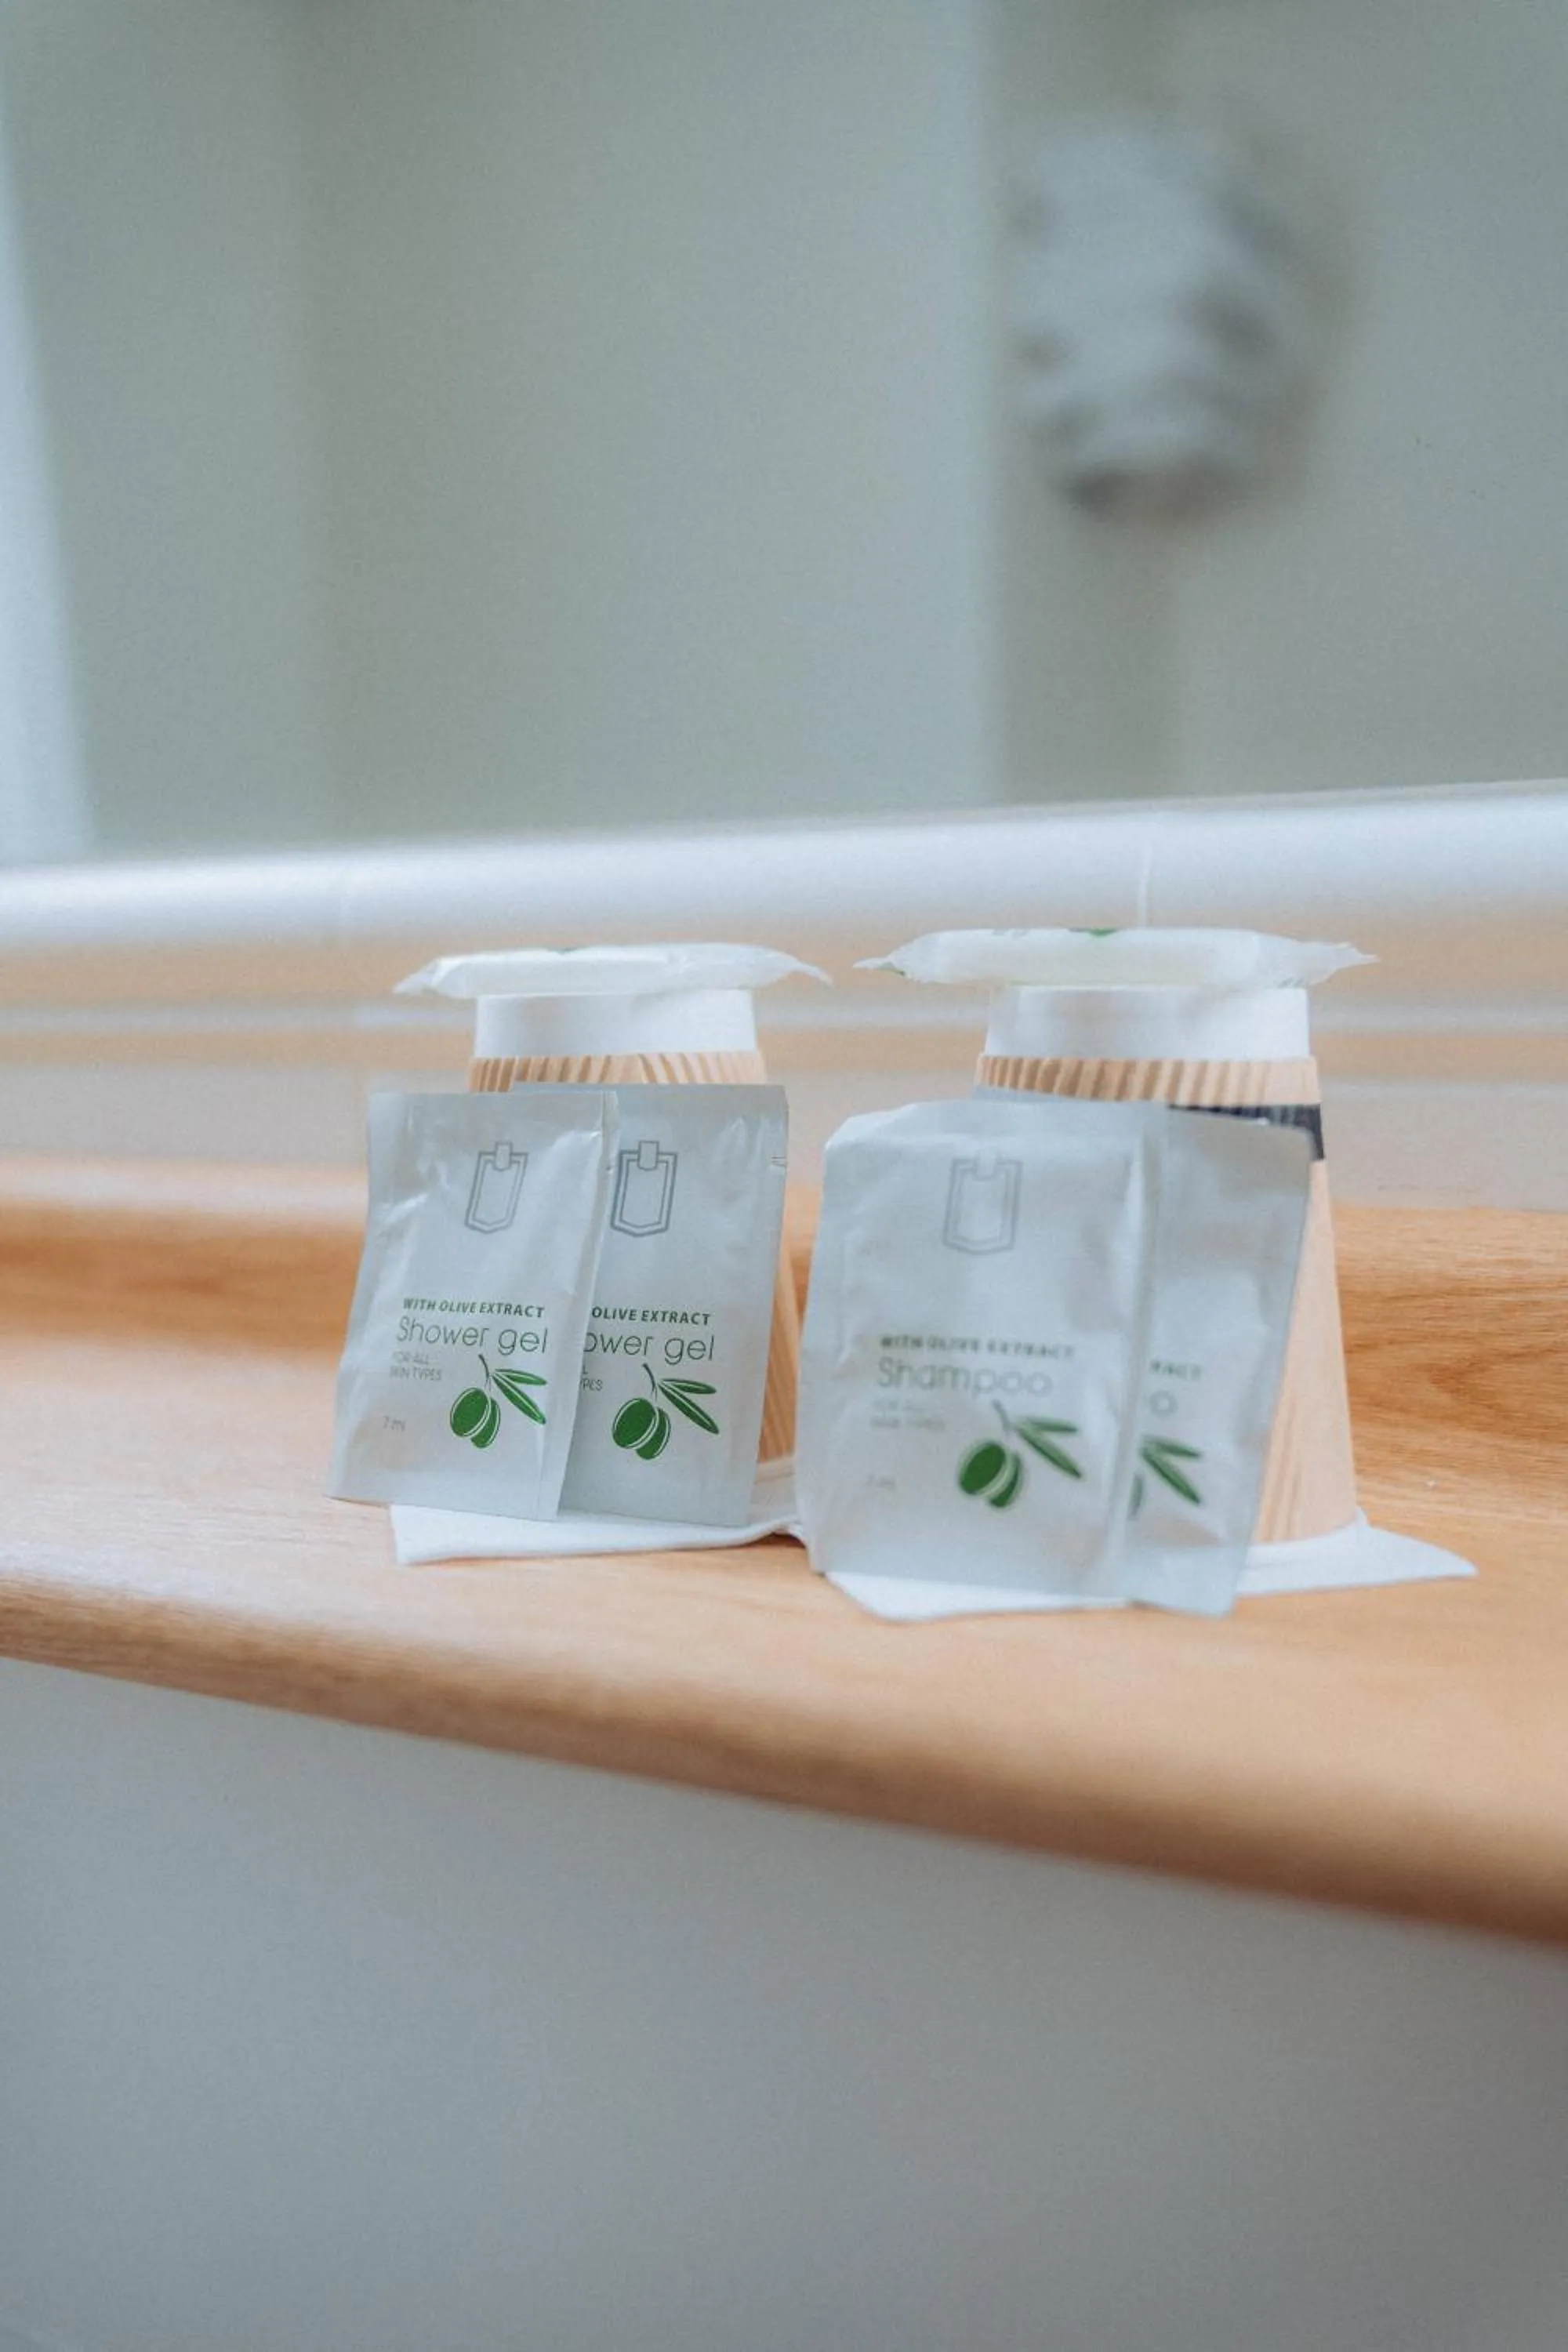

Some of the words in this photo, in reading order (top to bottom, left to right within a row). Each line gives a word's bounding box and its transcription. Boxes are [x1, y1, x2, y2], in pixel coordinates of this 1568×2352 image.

[403, 1298, 436, 1311] WITH
[438, 1300, 477, 1314] OLIVE
[479, 1302, 545, 1319] EXTRACT
[591, 1306, 637, 1322] OLIVE
[641, 1310, 712, 1326] EXTRACT
[396, 1316, 490, 1348] Shower
[497, 1327, 549, 1356] gel
[583, 1332, 655, 1356] ower
[664, 1334, 715, 1366] gel
[876, 1356, 1054, 1400] Shampoo
